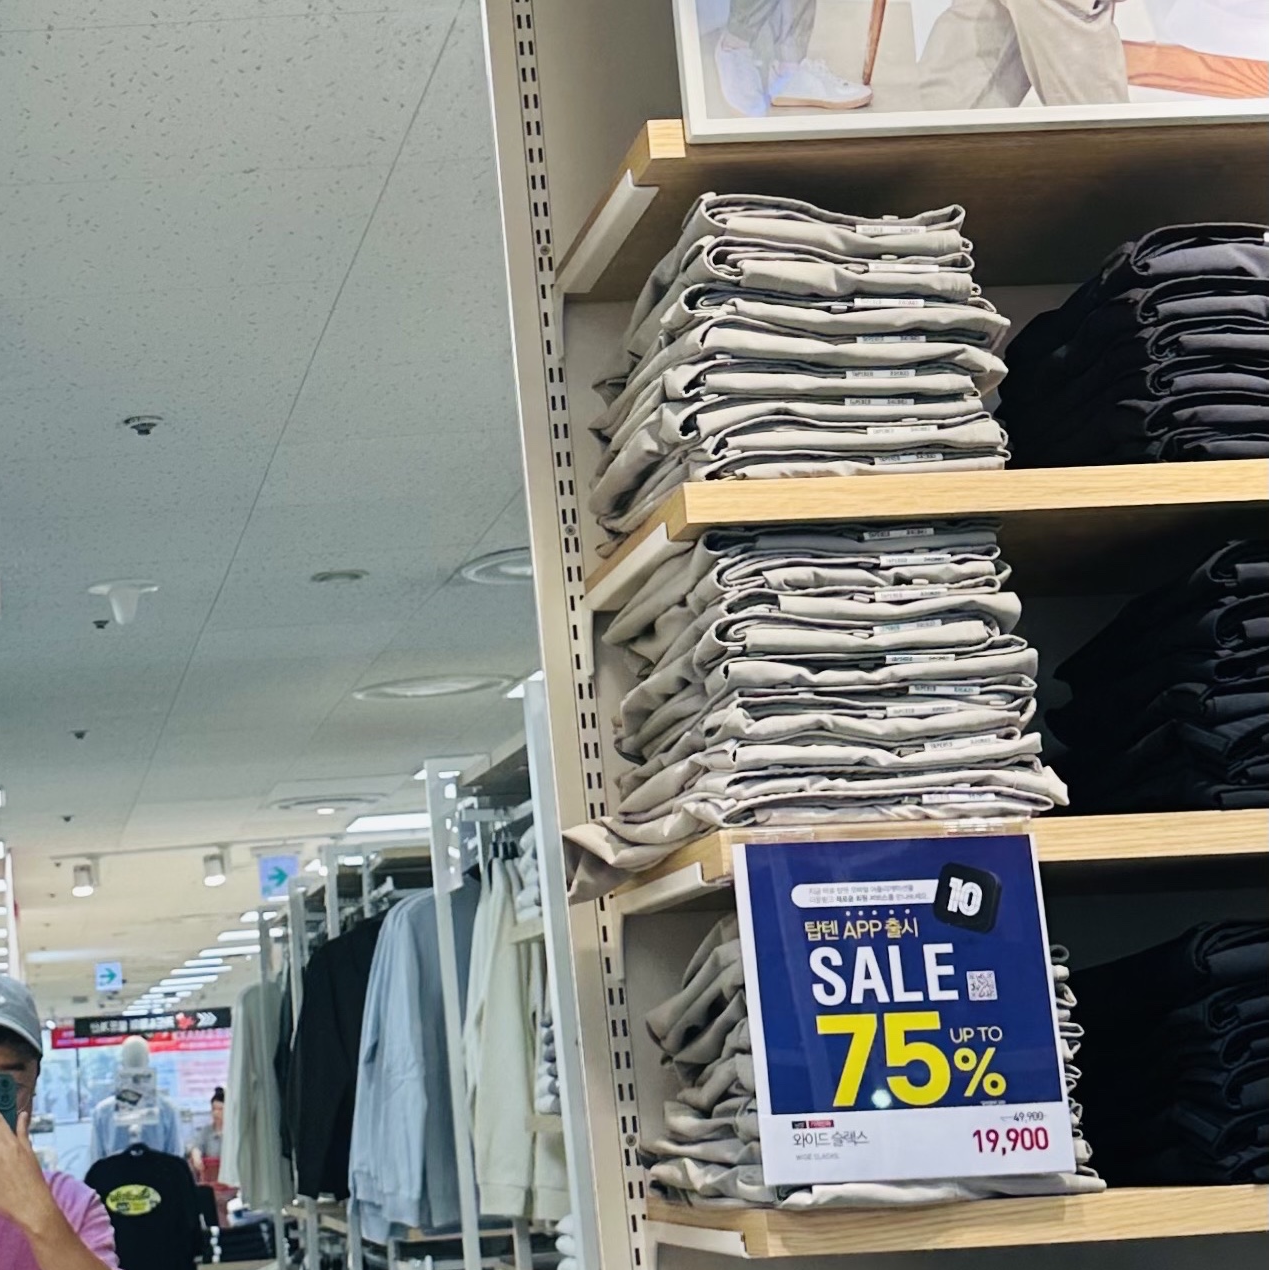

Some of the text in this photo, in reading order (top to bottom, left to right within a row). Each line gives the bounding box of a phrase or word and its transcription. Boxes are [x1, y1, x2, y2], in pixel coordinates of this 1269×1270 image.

[947, 877, 982, 917] 10
[804, 917, 919, 941] 탑텐 APP 출시
[809, 943, 959, 1006] SALE
[949, 1026, 1004, 1043] UP TO
[792, 1130, 870, 1148] 와이드 슬랙스
[972, 1127, 1049, 1156] 19,900
